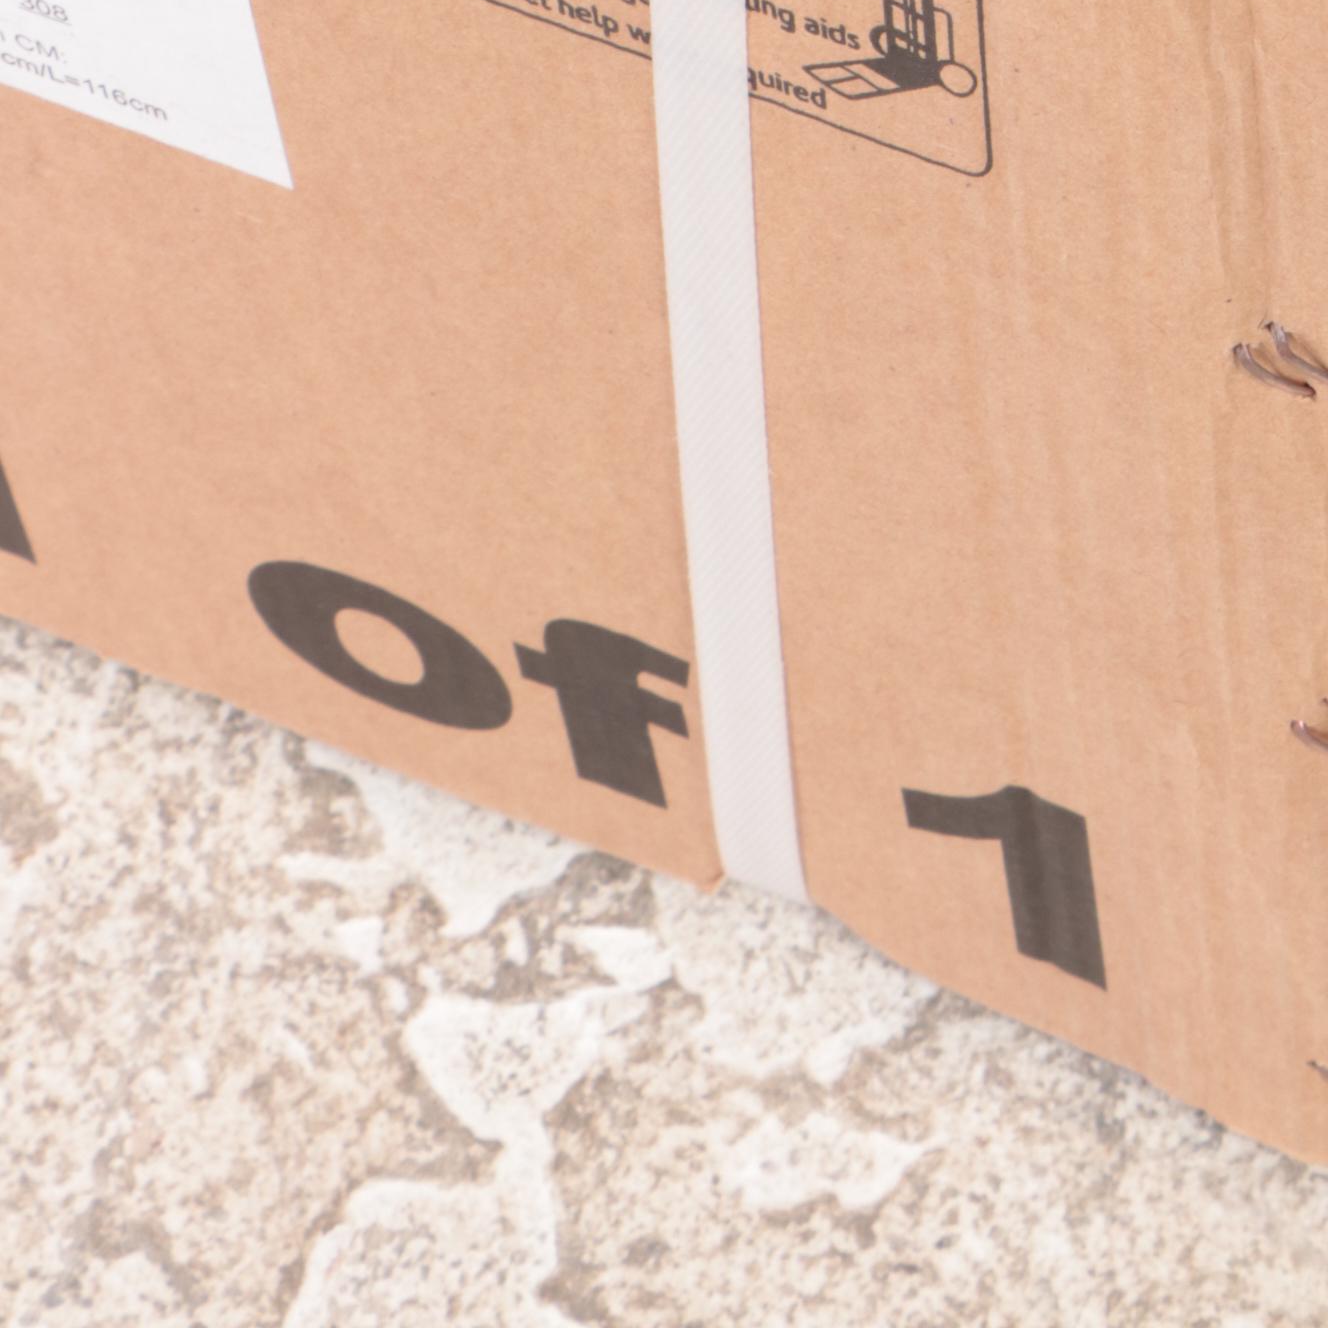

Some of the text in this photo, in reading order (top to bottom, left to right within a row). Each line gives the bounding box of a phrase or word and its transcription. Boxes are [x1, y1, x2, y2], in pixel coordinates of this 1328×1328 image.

[14, 33, 69, 65] CM:
[804, 16, 862, 51] aids
[747, 65, 828, 110] quired
[247, 560, 1108, 992] of 1
